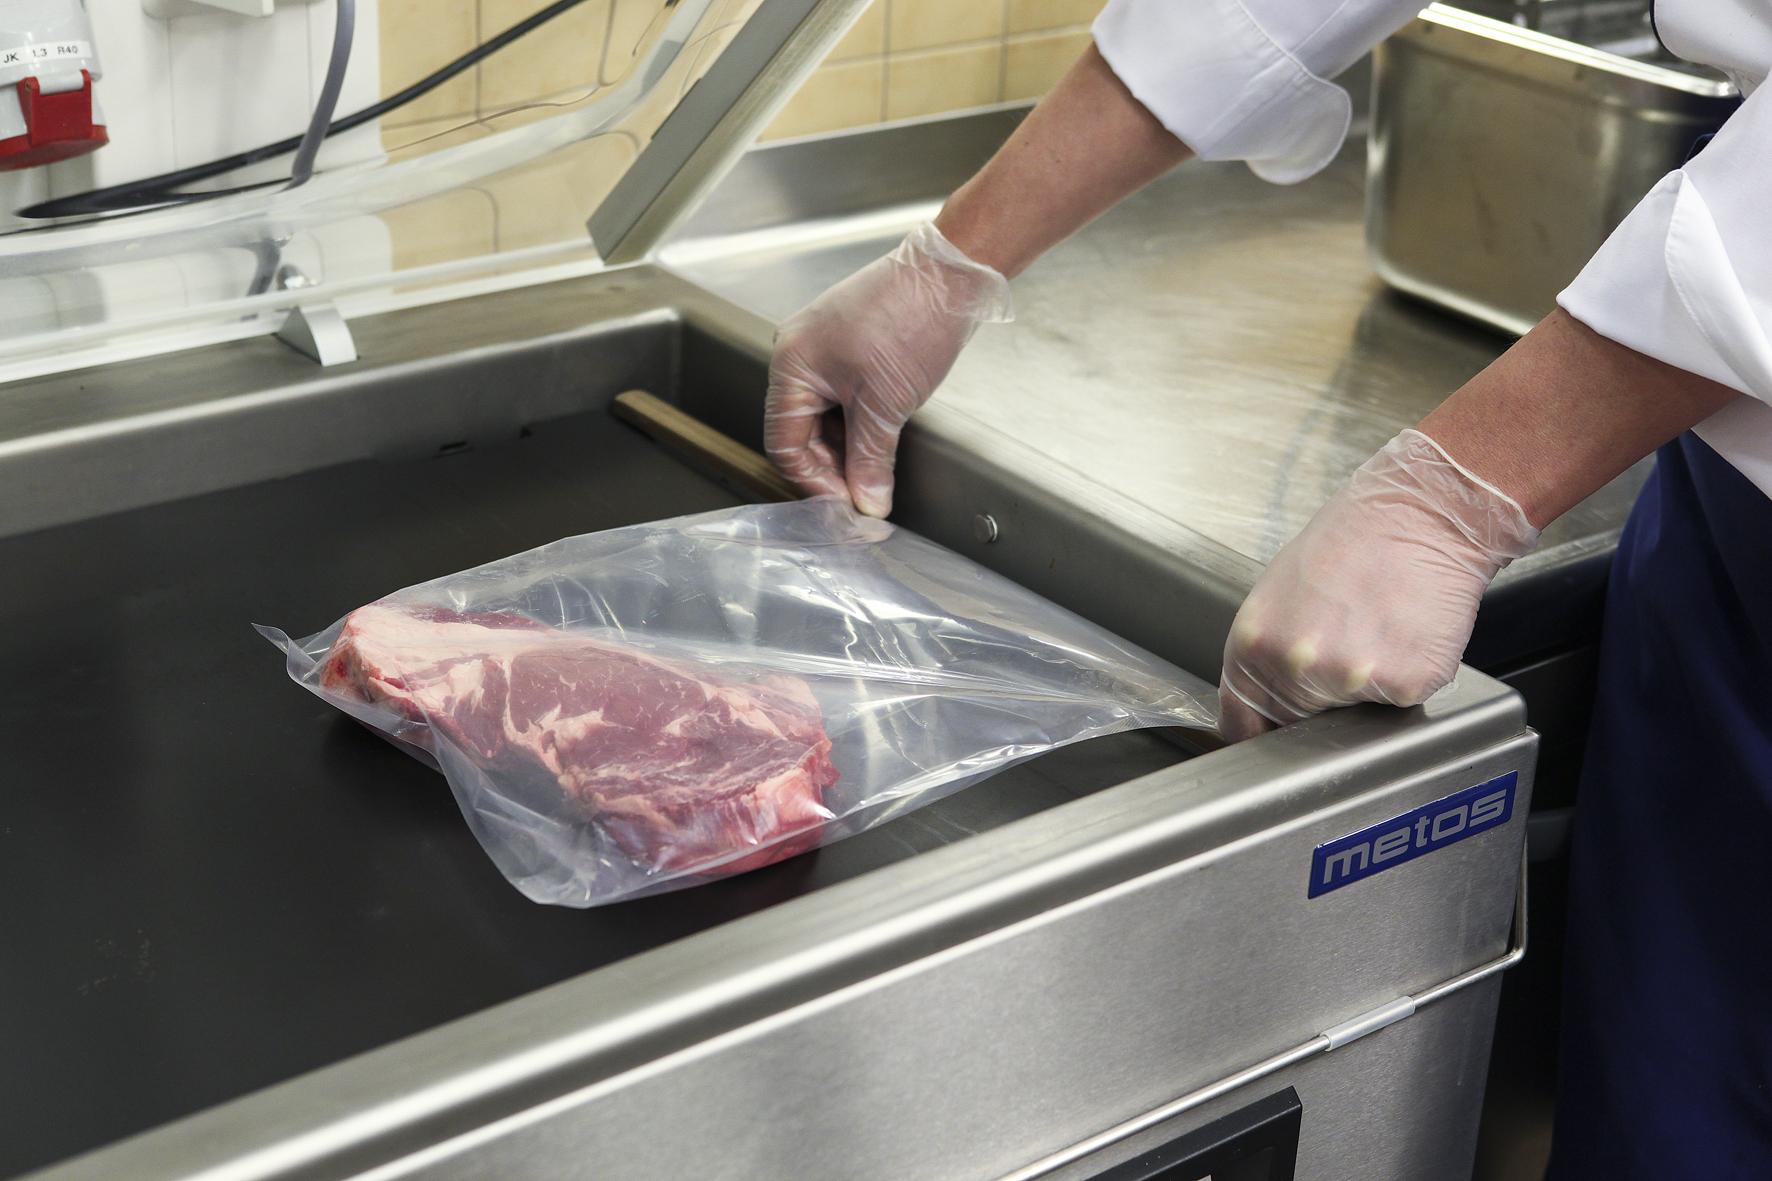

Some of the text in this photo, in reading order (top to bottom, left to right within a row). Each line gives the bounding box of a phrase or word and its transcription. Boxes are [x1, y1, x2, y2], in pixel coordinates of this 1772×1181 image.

[3, 52, 20, 63] JK
[57, 45, 79, 55] R40
[1323, 789, 1507, 884] metos
